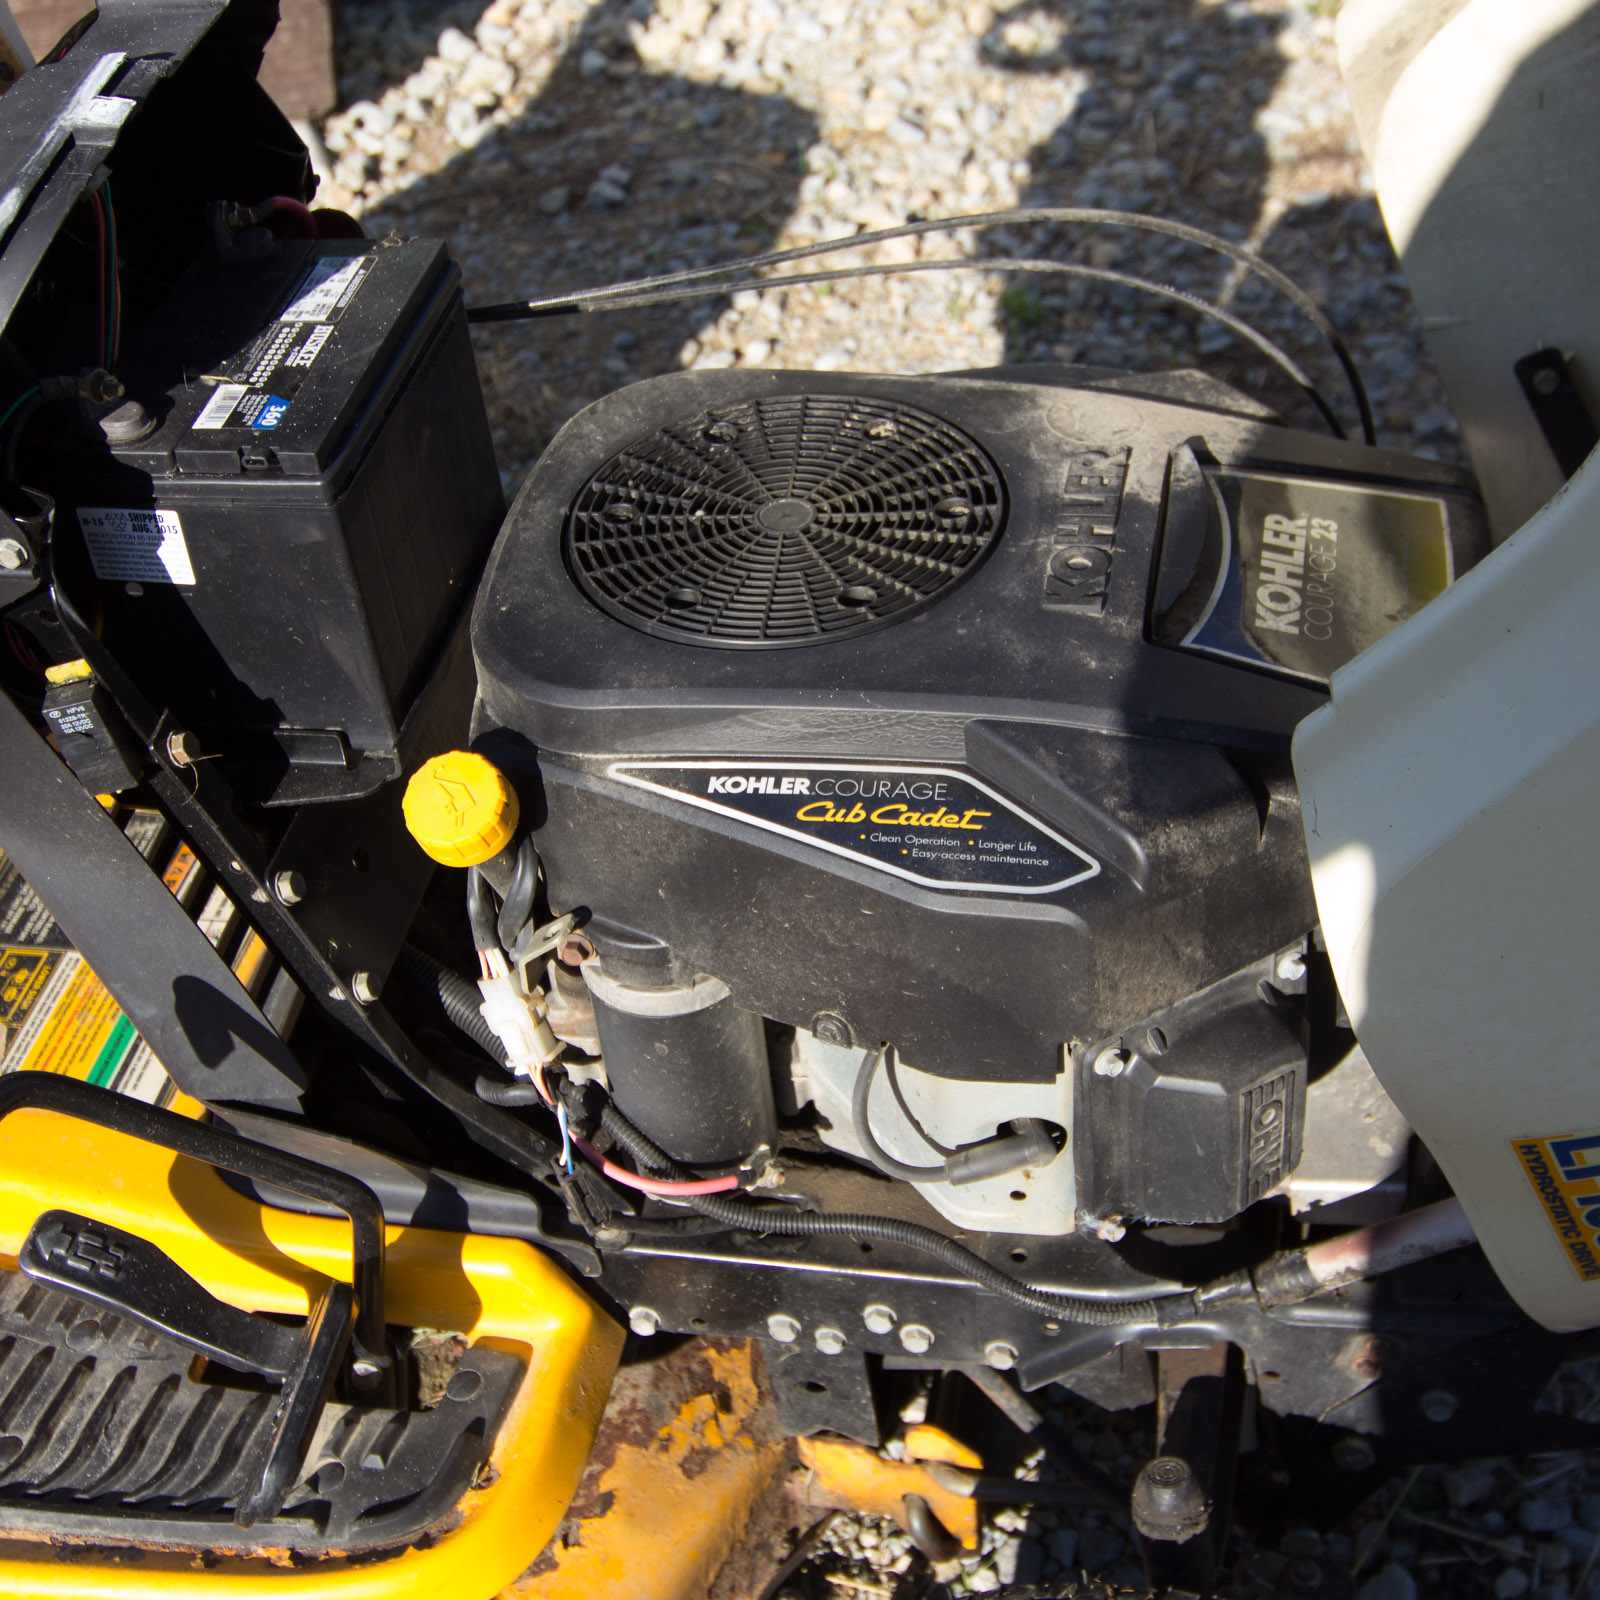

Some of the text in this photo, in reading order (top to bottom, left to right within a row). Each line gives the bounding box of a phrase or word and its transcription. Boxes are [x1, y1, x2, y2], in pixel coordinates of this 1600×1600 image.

[292, 324, 335, 369] HUSKEE
[261, 405, 287, 427] 360
[128, 512, 164, 524] SHIPPED
[132, 523, 178, 535] AUG. 2015
[1042, 445, 1133, 618] KOHLER
[1255, 514, 1307, 635] KOHLER
[1304, 517, 1338, 640] COURAGE 23
[707, 776, 948, 800] KOHLER COURAGE
[796, 801, 992, 830] Cub Cadet
[870, 832, 1037, 852] Clean Operation Longer Life
[912, 848, 1049, 866] Easy-access maintenance
[1518, 1144, 1582, 1239] HYDROSTATIC
[1569, 1242, 1600, 1277] DRIVE
